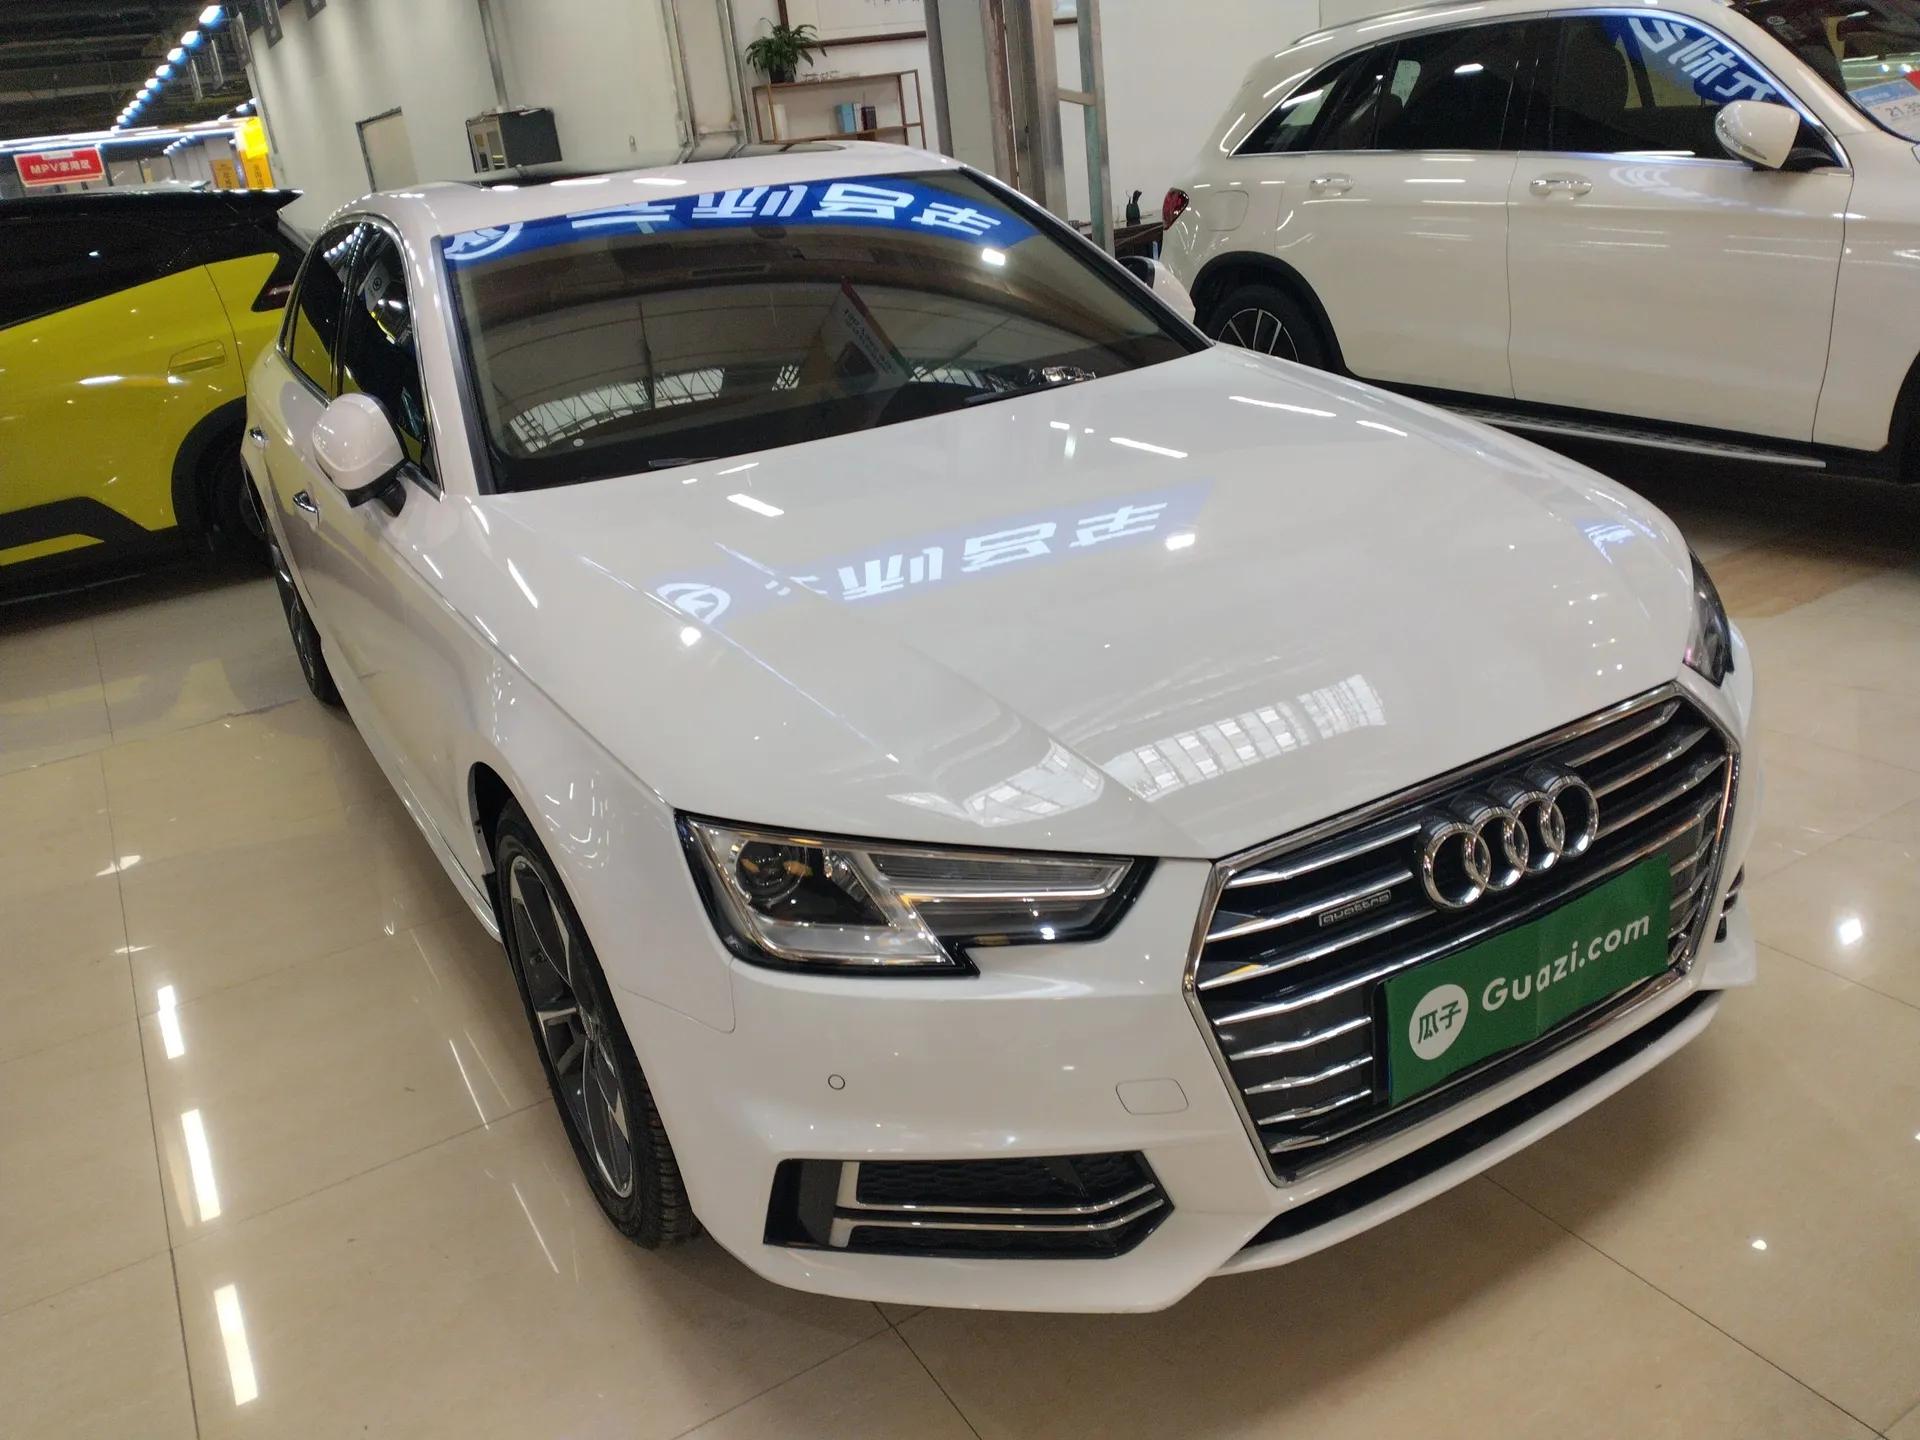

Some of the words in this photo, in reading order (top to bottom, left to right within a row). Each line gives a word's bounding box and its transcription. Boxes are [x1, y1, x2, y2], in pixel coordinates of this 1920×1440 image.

[1321, 892, 1391, 924] quattro
[1482, 915, 1650, 1012] Guazi.com
[1418, 1000, 1462, 1045] 瓜子
